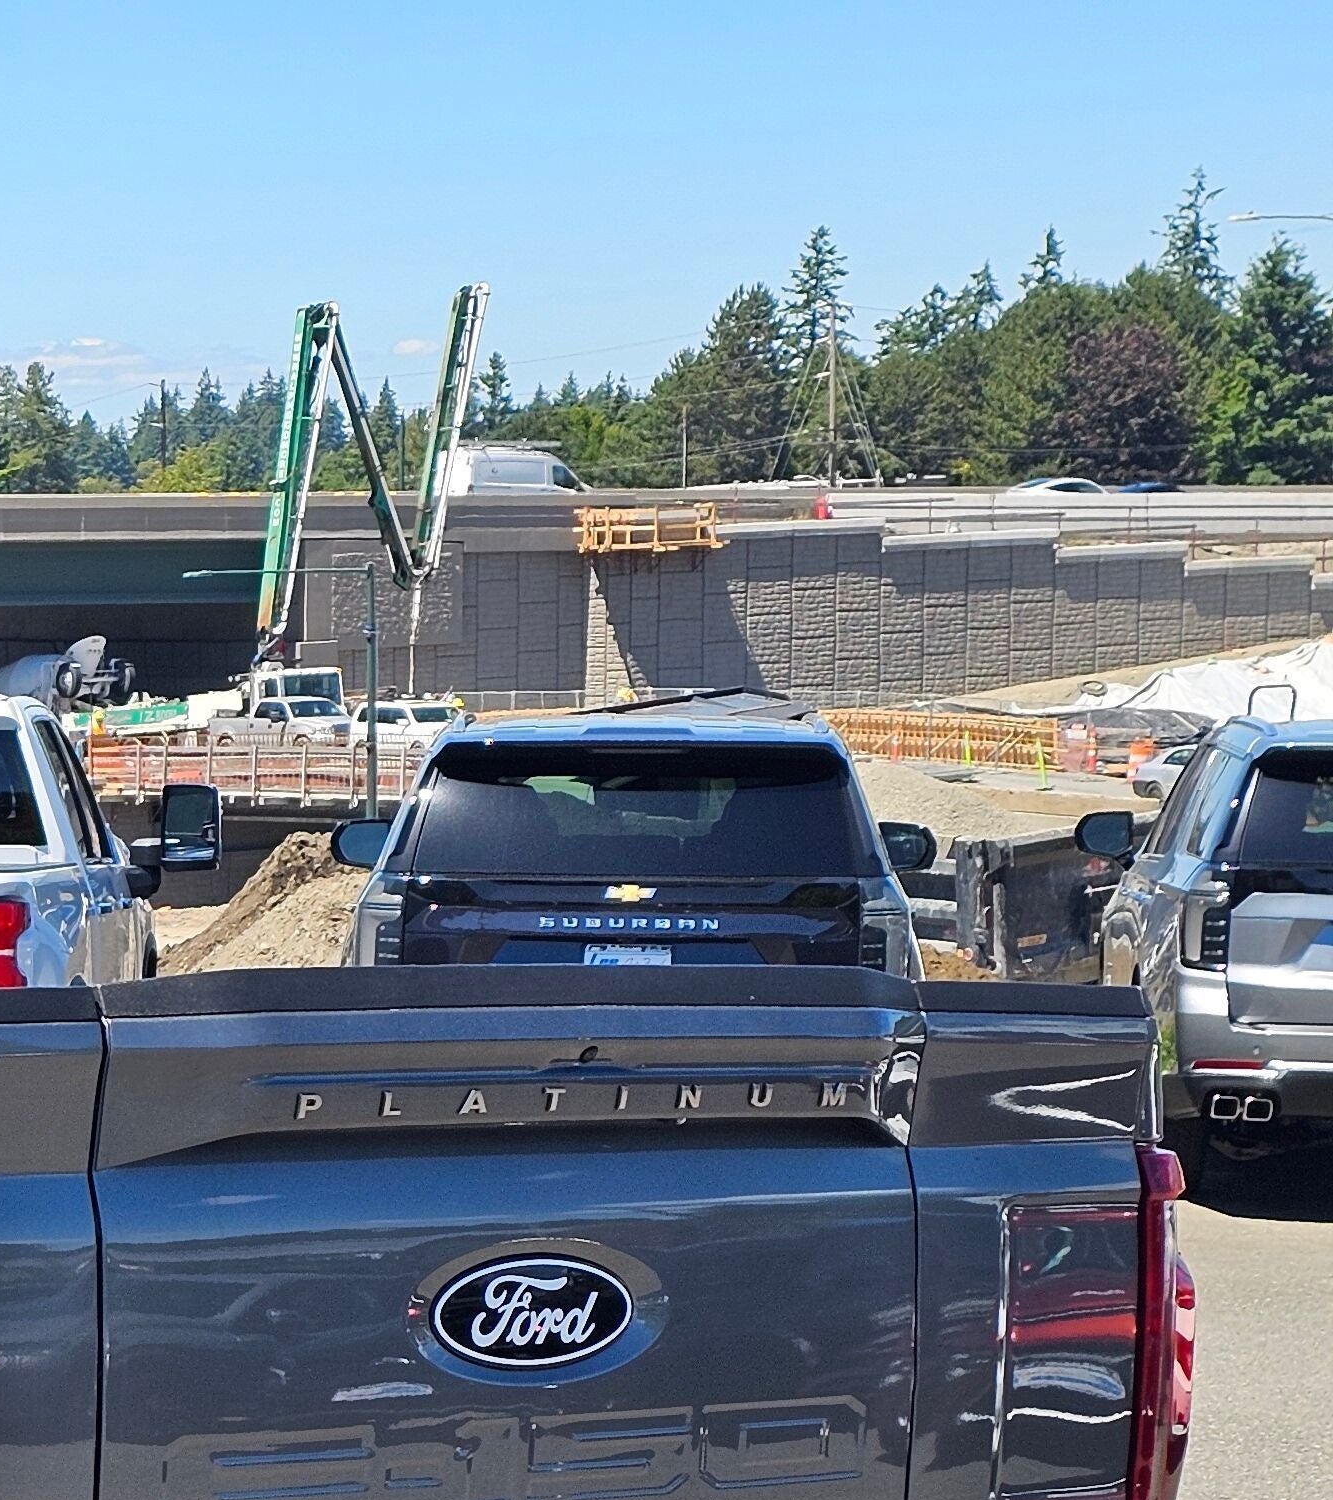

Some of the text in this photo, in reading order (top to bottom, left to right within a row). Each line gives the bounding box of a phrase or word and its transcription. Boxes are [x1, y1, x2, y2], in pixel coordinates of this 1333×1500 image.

[538, 916, 719, 930] SUBURBAN
[295, 1082, 851, 1121] PLATINUM
[470, 1273, 599, 1348] Ford
